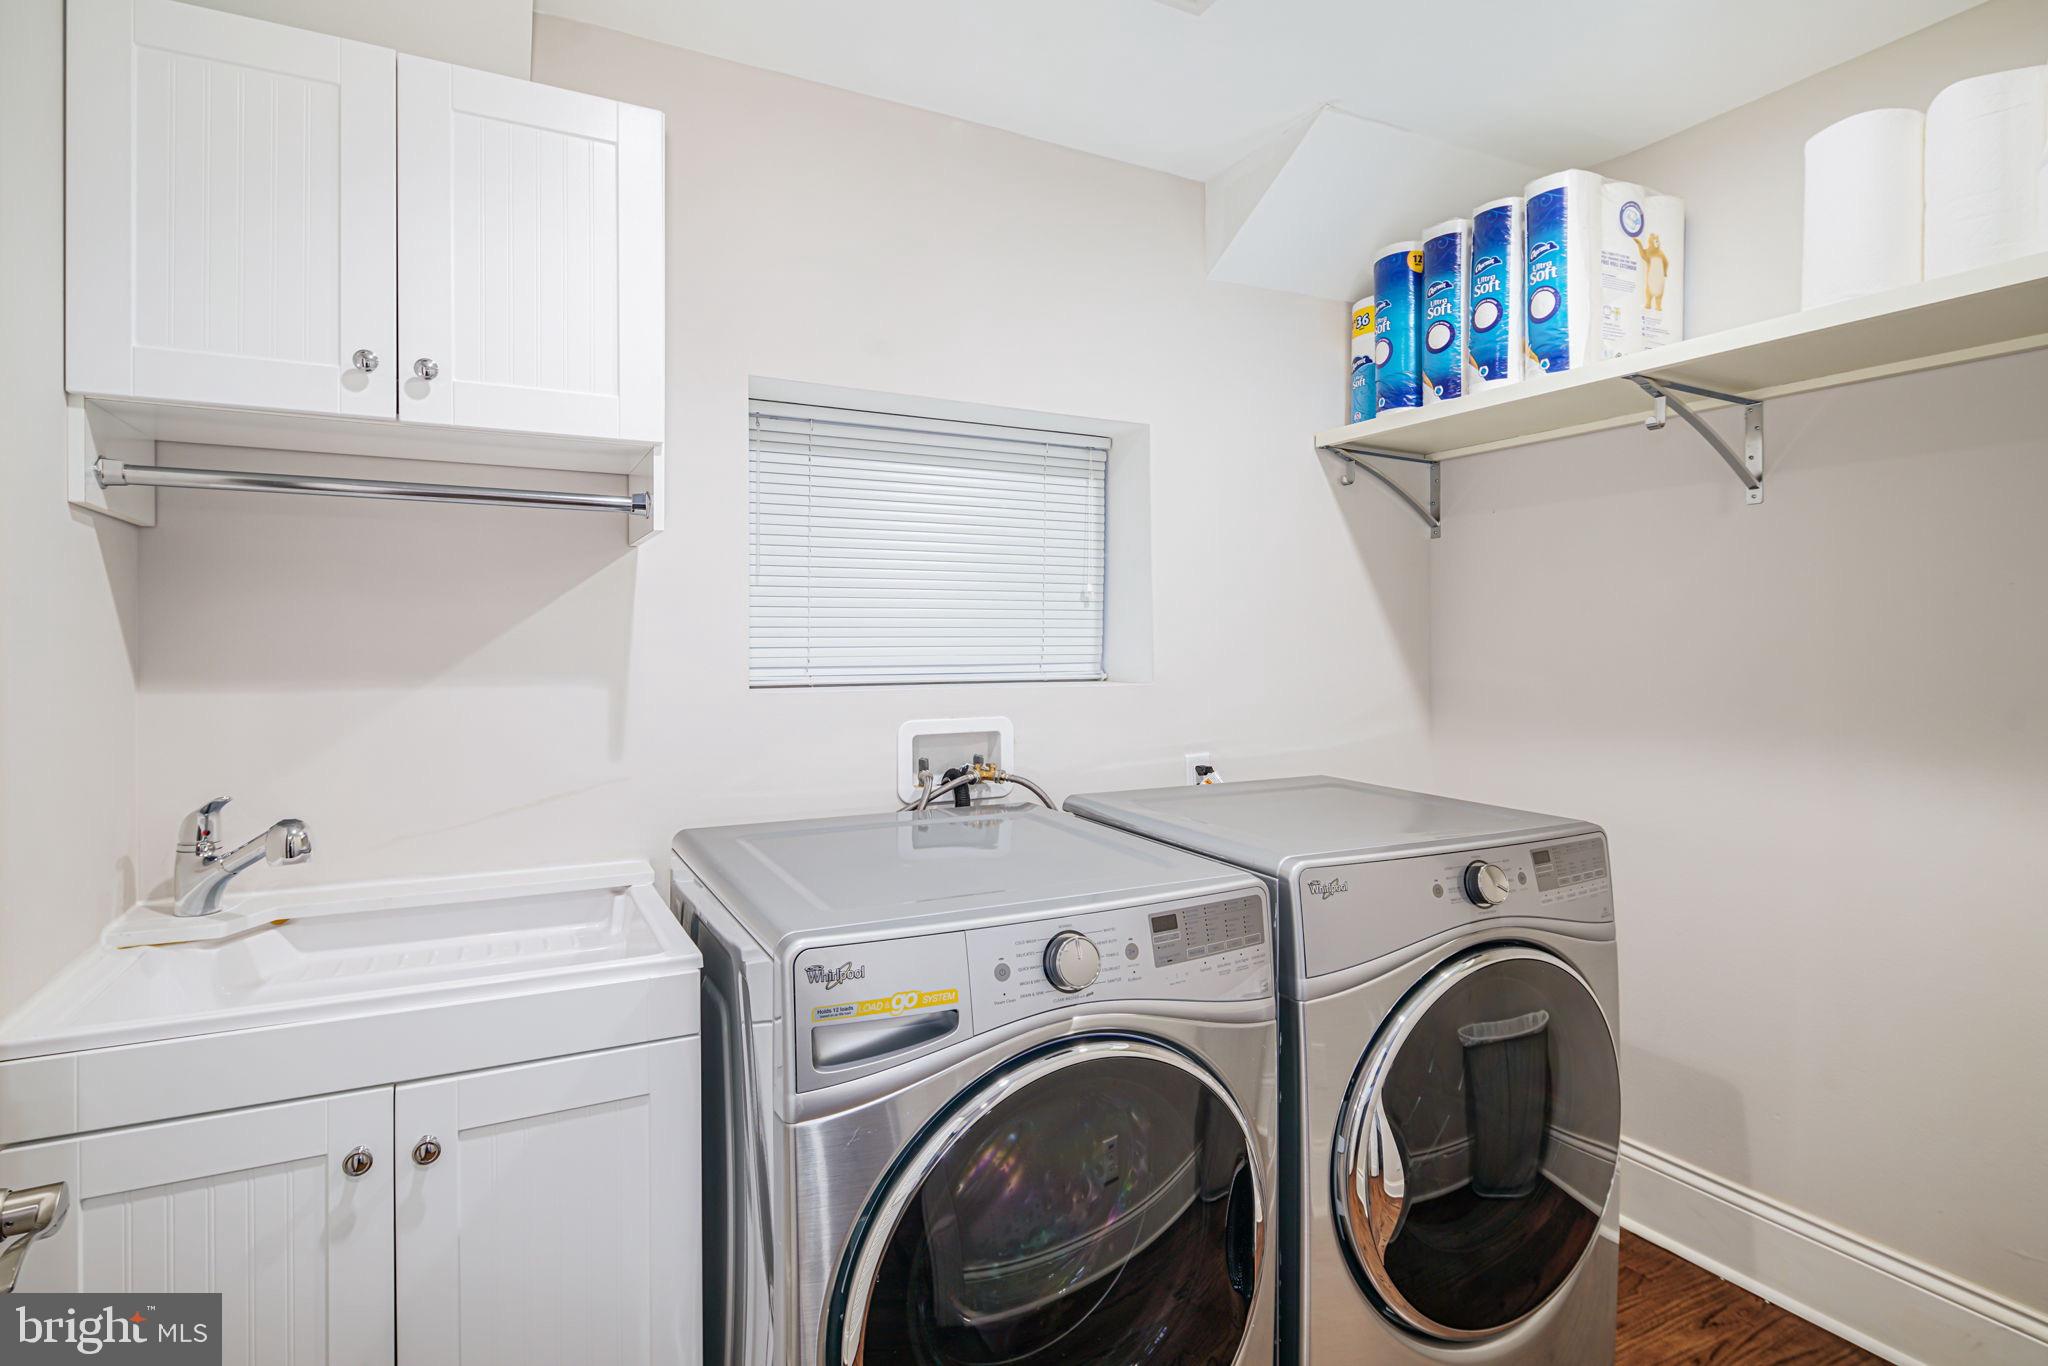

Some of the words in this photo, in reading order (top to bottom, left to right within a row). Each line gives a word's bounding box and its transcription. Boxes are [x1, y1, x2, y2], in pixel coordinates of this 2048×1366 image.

[1413, 254, 1423, 264] 12
[1532, 261, 1552, 271] Ultra
[1477, 275, 1496, 284] Ultra
[1430, 298, 1448, 307] Ultra
[1355, 312, 1371, 330] 36
[1308, 878, 1348, 899] Whirlpool
[805, 963, 866, 989] Whirlpool
[892, 992, 918, 1015] go
[922, 991, 957, 1004] SYSTEM
[816, 1007, 832, 1015] Holds
[840, 1004, 854, 1012] loads
